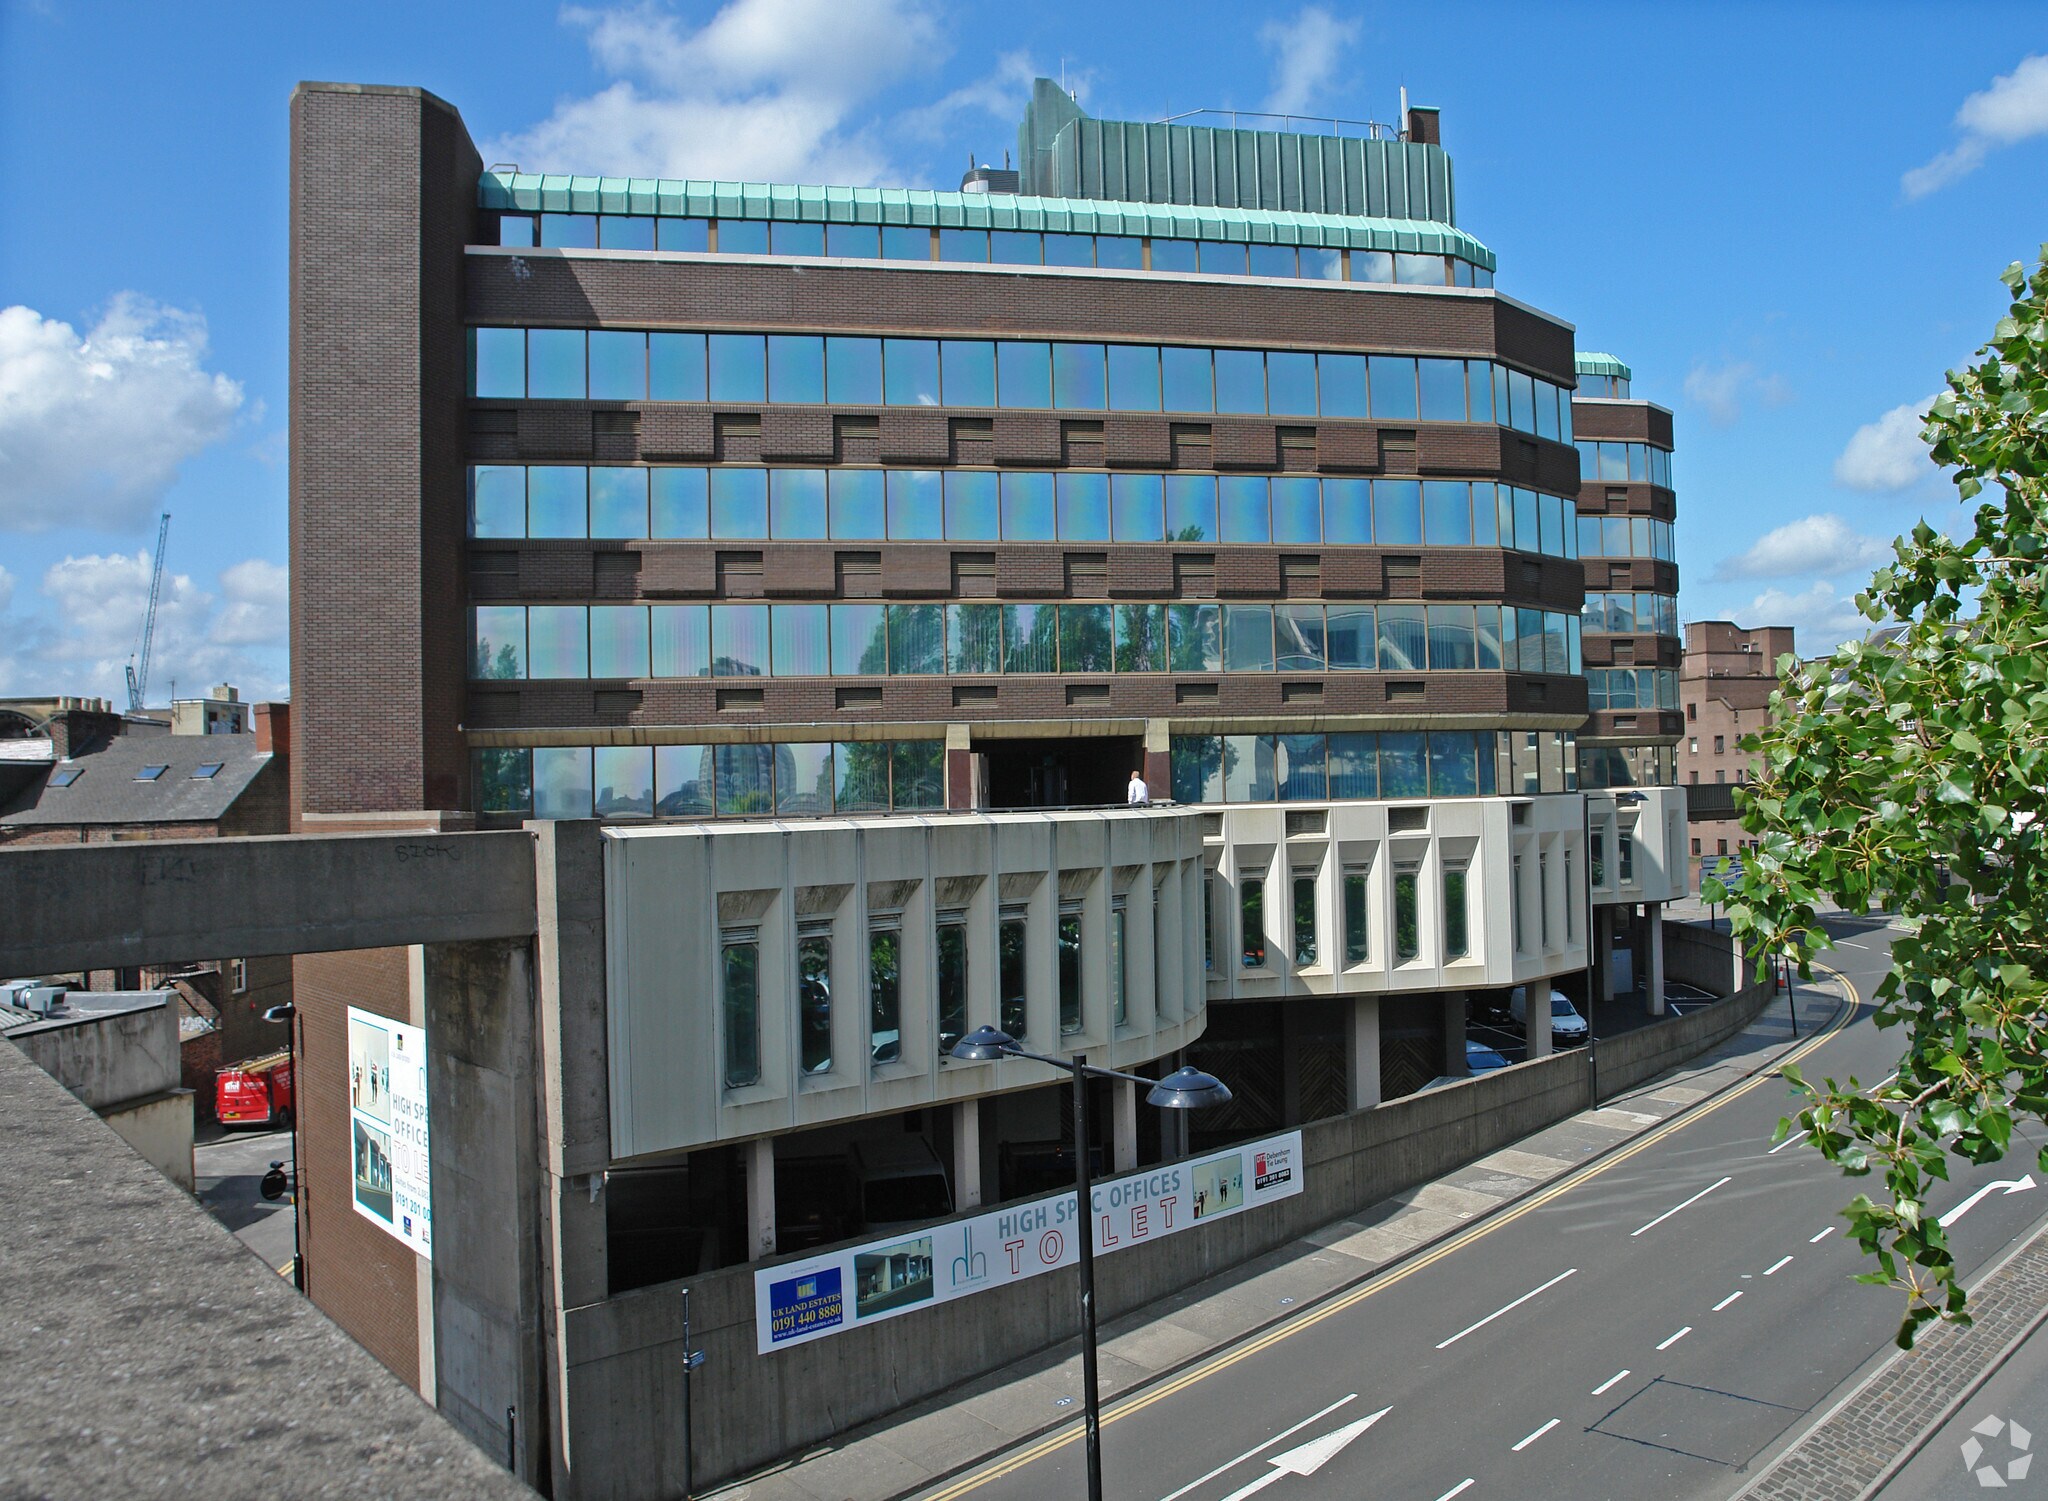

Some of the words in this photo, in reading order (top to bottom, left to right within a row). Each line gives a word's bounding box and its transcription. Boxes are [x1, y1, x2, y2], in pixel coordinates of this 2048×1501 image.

[393, 1093, 411, 1116] HIGH
[394, 1140, 409, 1173] TO
[395, 1191, 409, 1209] 0191
[410, 1199, 421, 1216] 201
[998, 1206, 1047, 1239] HIGH
[1055, 1191, 1102, 1224] SPC
[1109, 1170, 1180, 1208] OFFICES
[1004, 1230, 1064, 1275] TO
[1102, 1196, 1177, 1247] LET
[772, 1307, 784, 1318] UK
[785, 1302, 807, 1315] LAND
[808, 1292, 842, 1309] ESTATES
[772, 1315, 795, 1332] 0191
[797, 1309, 816, 1325] 440
[818, 1302, 842, 1320] 8880
